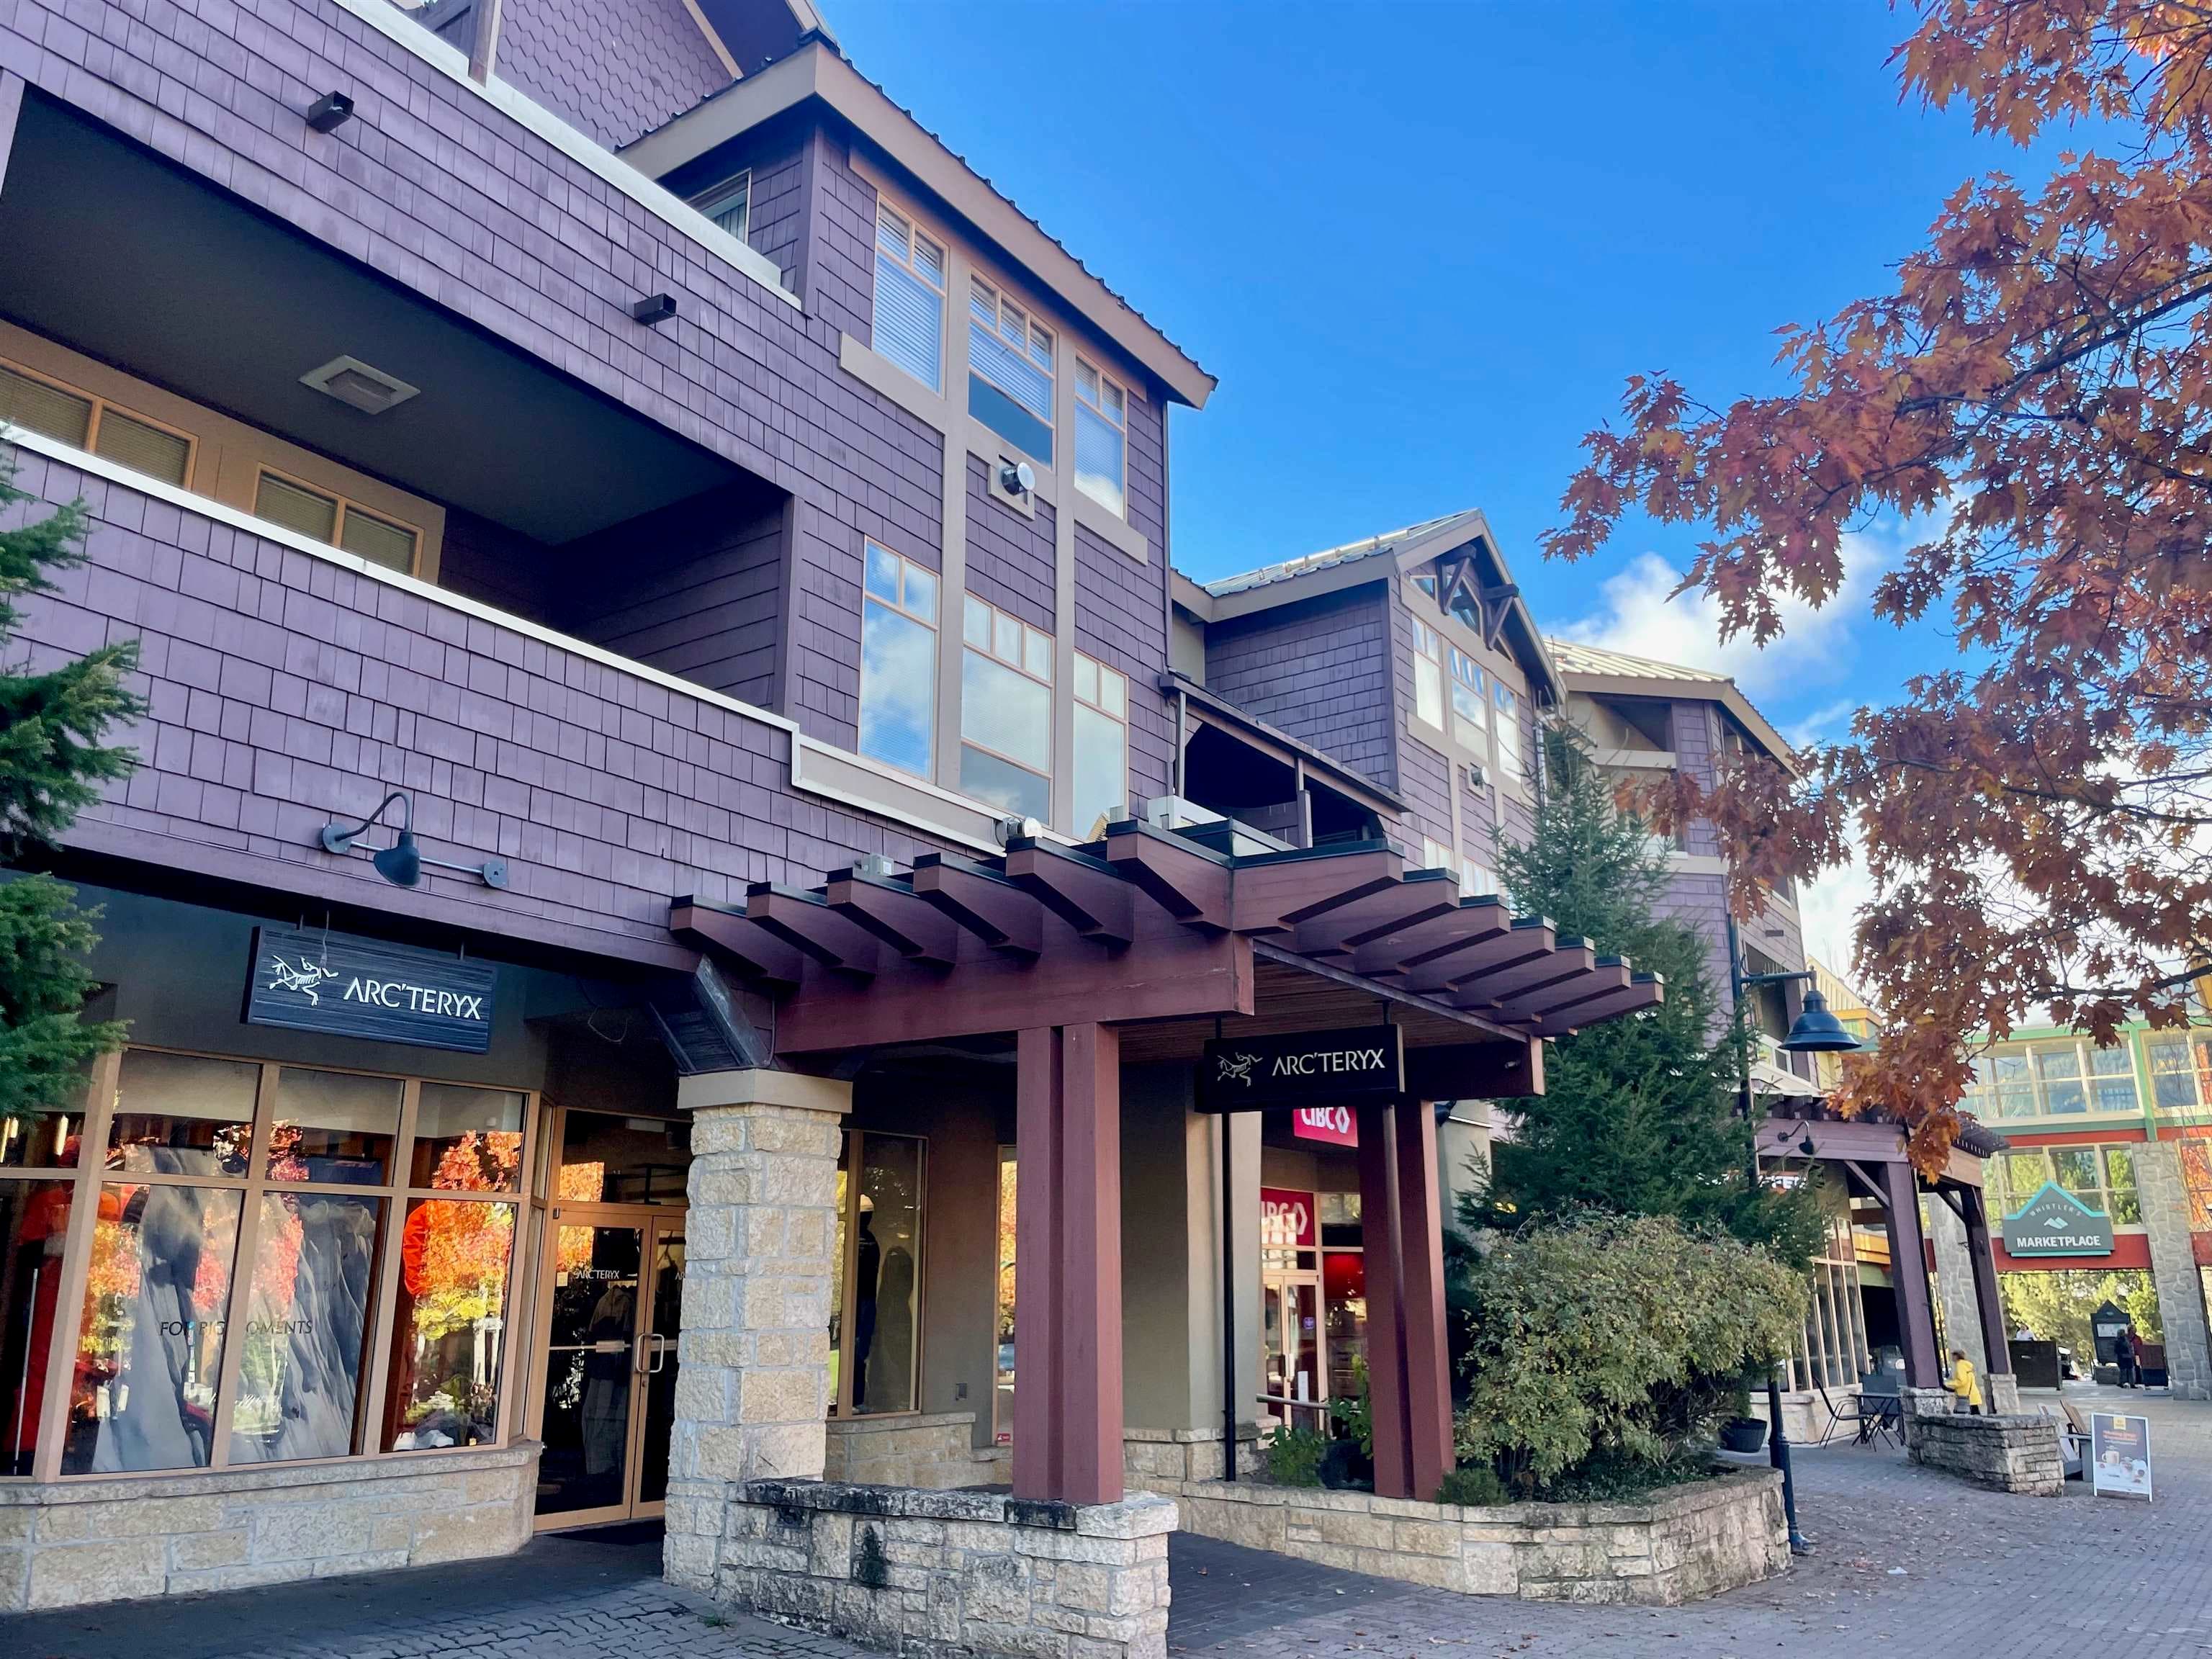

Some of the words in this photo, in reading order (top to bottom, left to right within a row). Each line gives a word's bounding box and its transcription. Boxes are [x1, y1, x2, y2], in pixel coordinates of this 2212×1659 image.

[343, 977, 482, 1020] ARC'TERYX
[1272, 1048, 1385, 1076] ARC'TERYX
[1300, 1107, 1335, 1130] CIBC
[2016, 1235, 2102, 1249] MARKETPLACE
[246, 1320, 313, 1335] OMENTS
